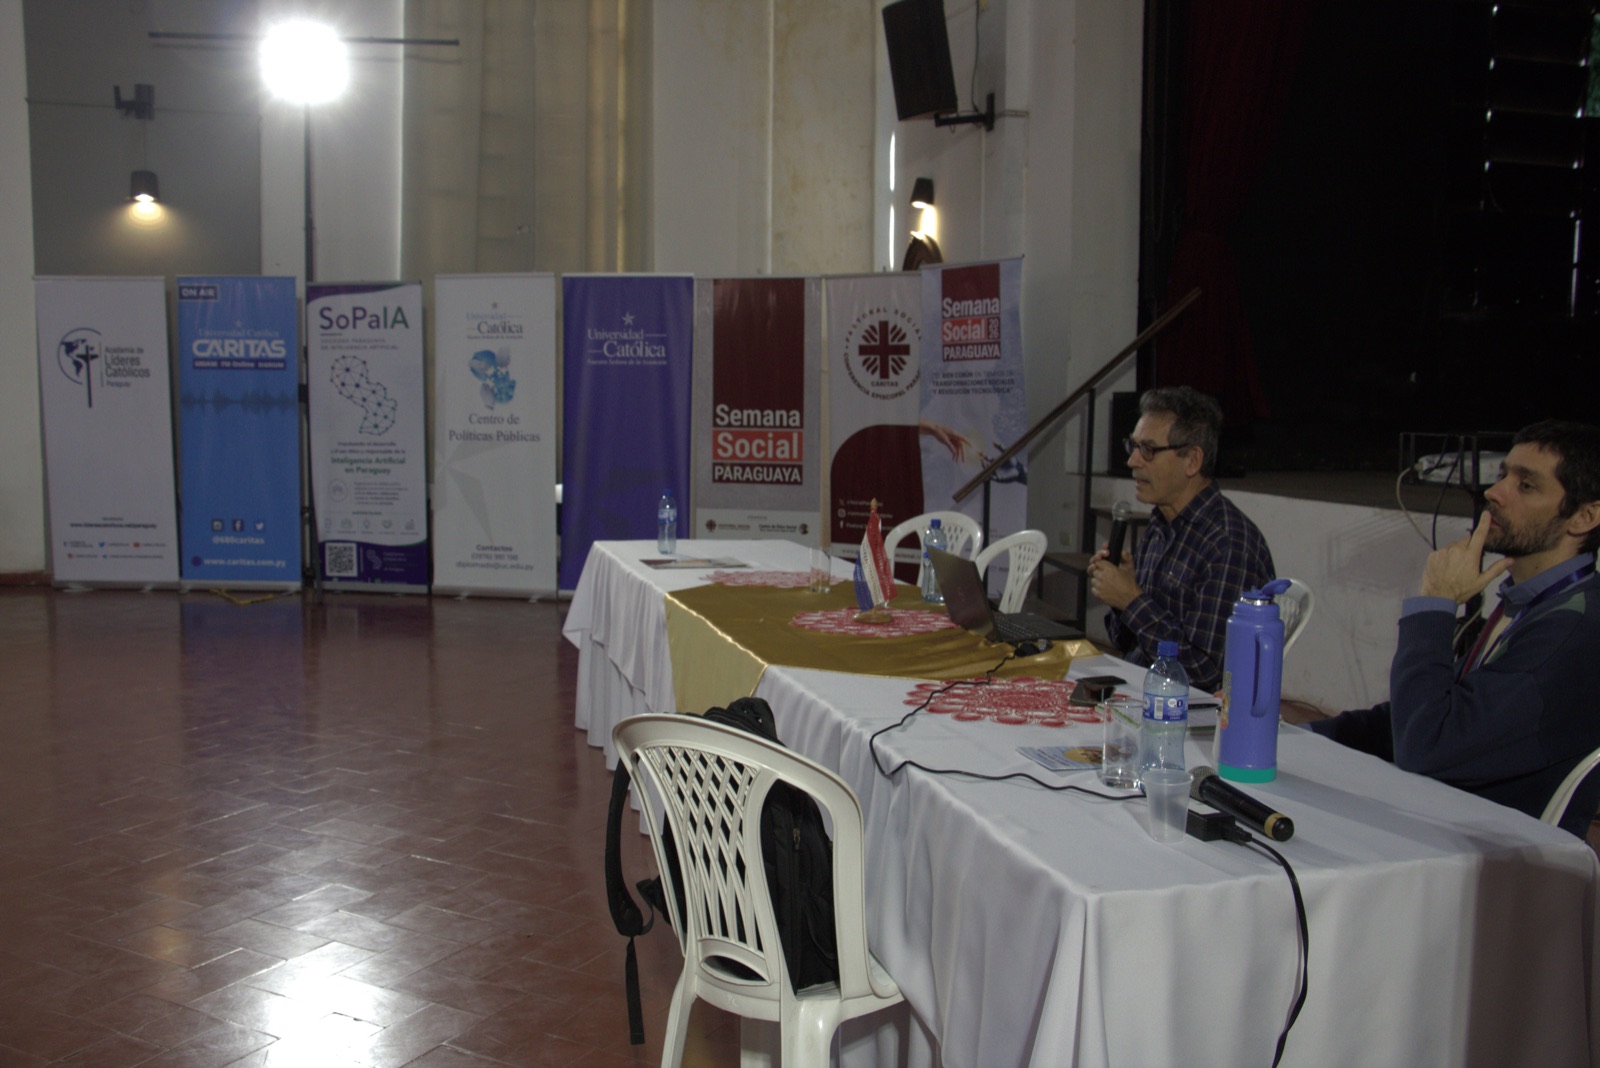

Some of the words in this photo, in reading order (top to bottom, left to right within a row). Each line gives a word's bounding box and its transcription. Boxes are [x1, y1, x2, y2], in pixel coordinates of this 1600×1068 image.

[181, 288, 198, 297] ON
[199, 288, 215, 297] AIR
[942, 297, 1000, 318] Semana
[477, 321, 524, 334] Católica
[587, 328, 644, 340] Universidad
[943, 319, 986, 342] Social
[192, 339, 287, 358] CARITAS
[602, 340, 666, 358] Católica
[942, 344, 1000, 360] PARAGUAYA
[105, 366, 151, 378] Católicos
[468, 412, 504, 425] Centro
[506, 412, 520, 425] de
[715, 403, 801, 427] Semana
[448, 430, 494, 442] Políticas
[496, 430, 542, 442] Públicas
[716, 432, 799, 460] Social
[356, 466, 391, 475] Paraguay
[714, 466, 802, 483] PARAGUAYA
[476, 544, 513, 552] Contactos
